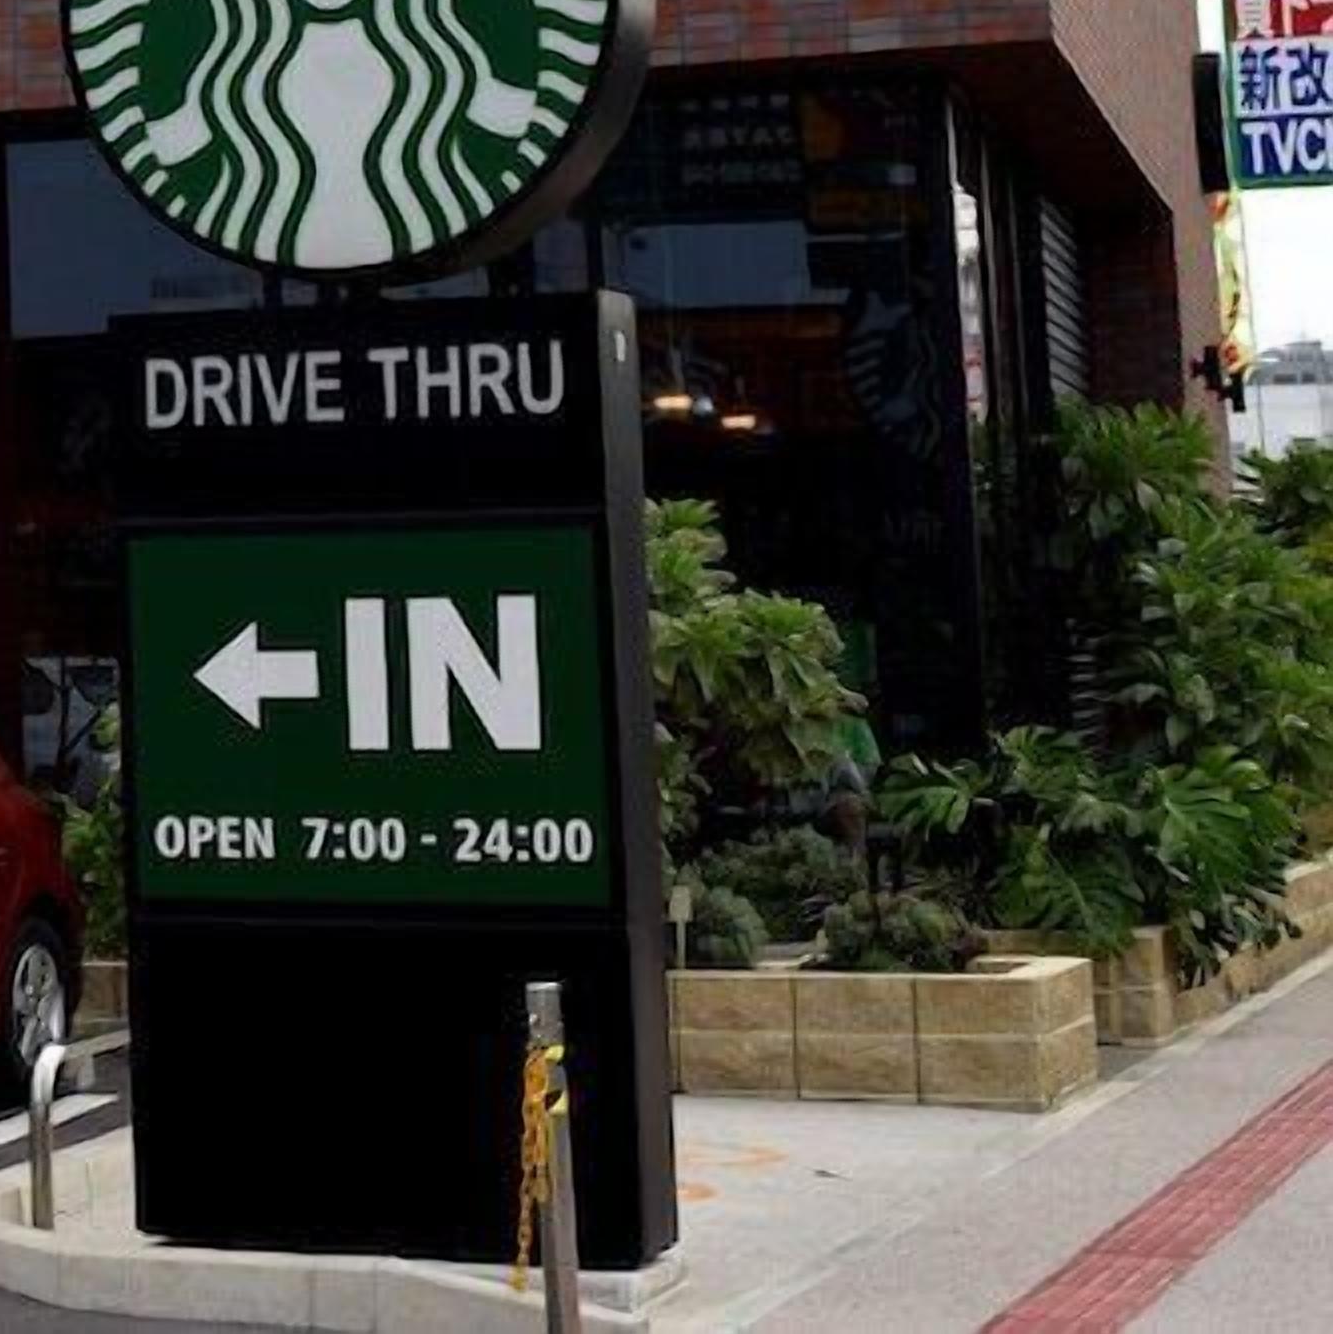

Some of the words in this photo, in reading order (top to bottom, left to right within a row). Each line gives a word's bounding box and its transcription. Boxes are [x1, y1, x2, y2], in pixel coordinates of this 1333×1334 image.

[1241, 116, 1333, 175] TVC
[146, 352, 344, 427] DRIVE
[369, 341, 563, 418] THRU
[346, 595, 540, 750] IN
[155, 816, 274, 858] OPEN
[302, 818, 405, 861] 7:00
[454, 819, 592, 861] 24:00
